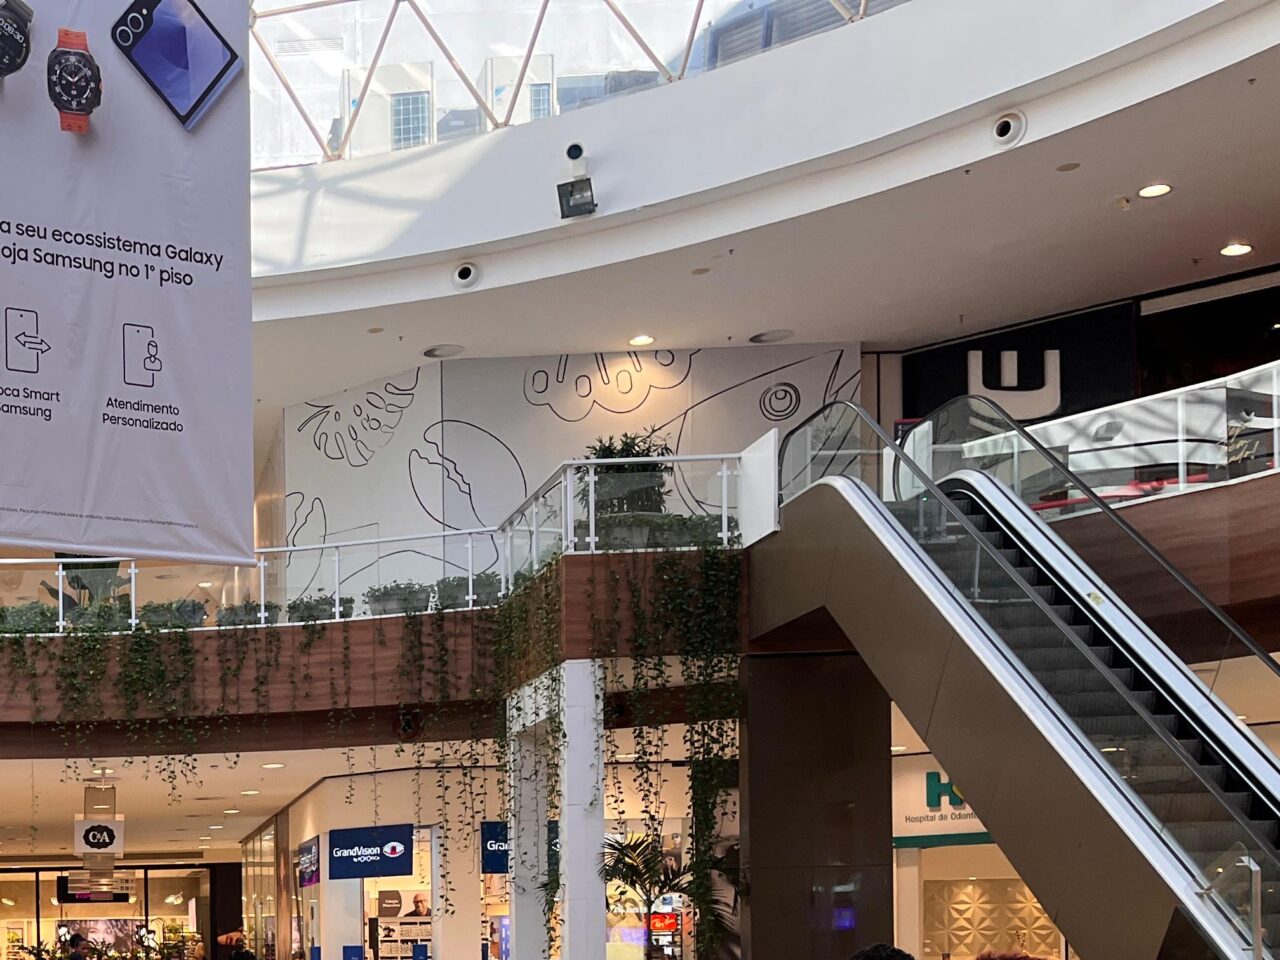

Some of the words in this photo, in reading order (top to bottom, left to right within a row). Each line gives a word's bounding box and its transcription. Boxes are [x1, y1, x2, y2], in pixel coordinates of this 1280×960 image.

[15, 223, 47, 240] seu
[51, 228, 162, 257] ecossistema
[165, 244, 224, 272] Galaxy
[33, 248, 115, 279] Samsung
[119, 262, 140, 278] no
[159, 268, 193, 287] piso
[22, 387, 61, 402] Smart
[106, 397, 180, 416] Atendimento
[102, 413, 184, 432] Personalizado
[905, 814, 936, 823] Hospital
[89, 831, 110, 843] C&A
[333, 845, 380, 858] GrandVision
